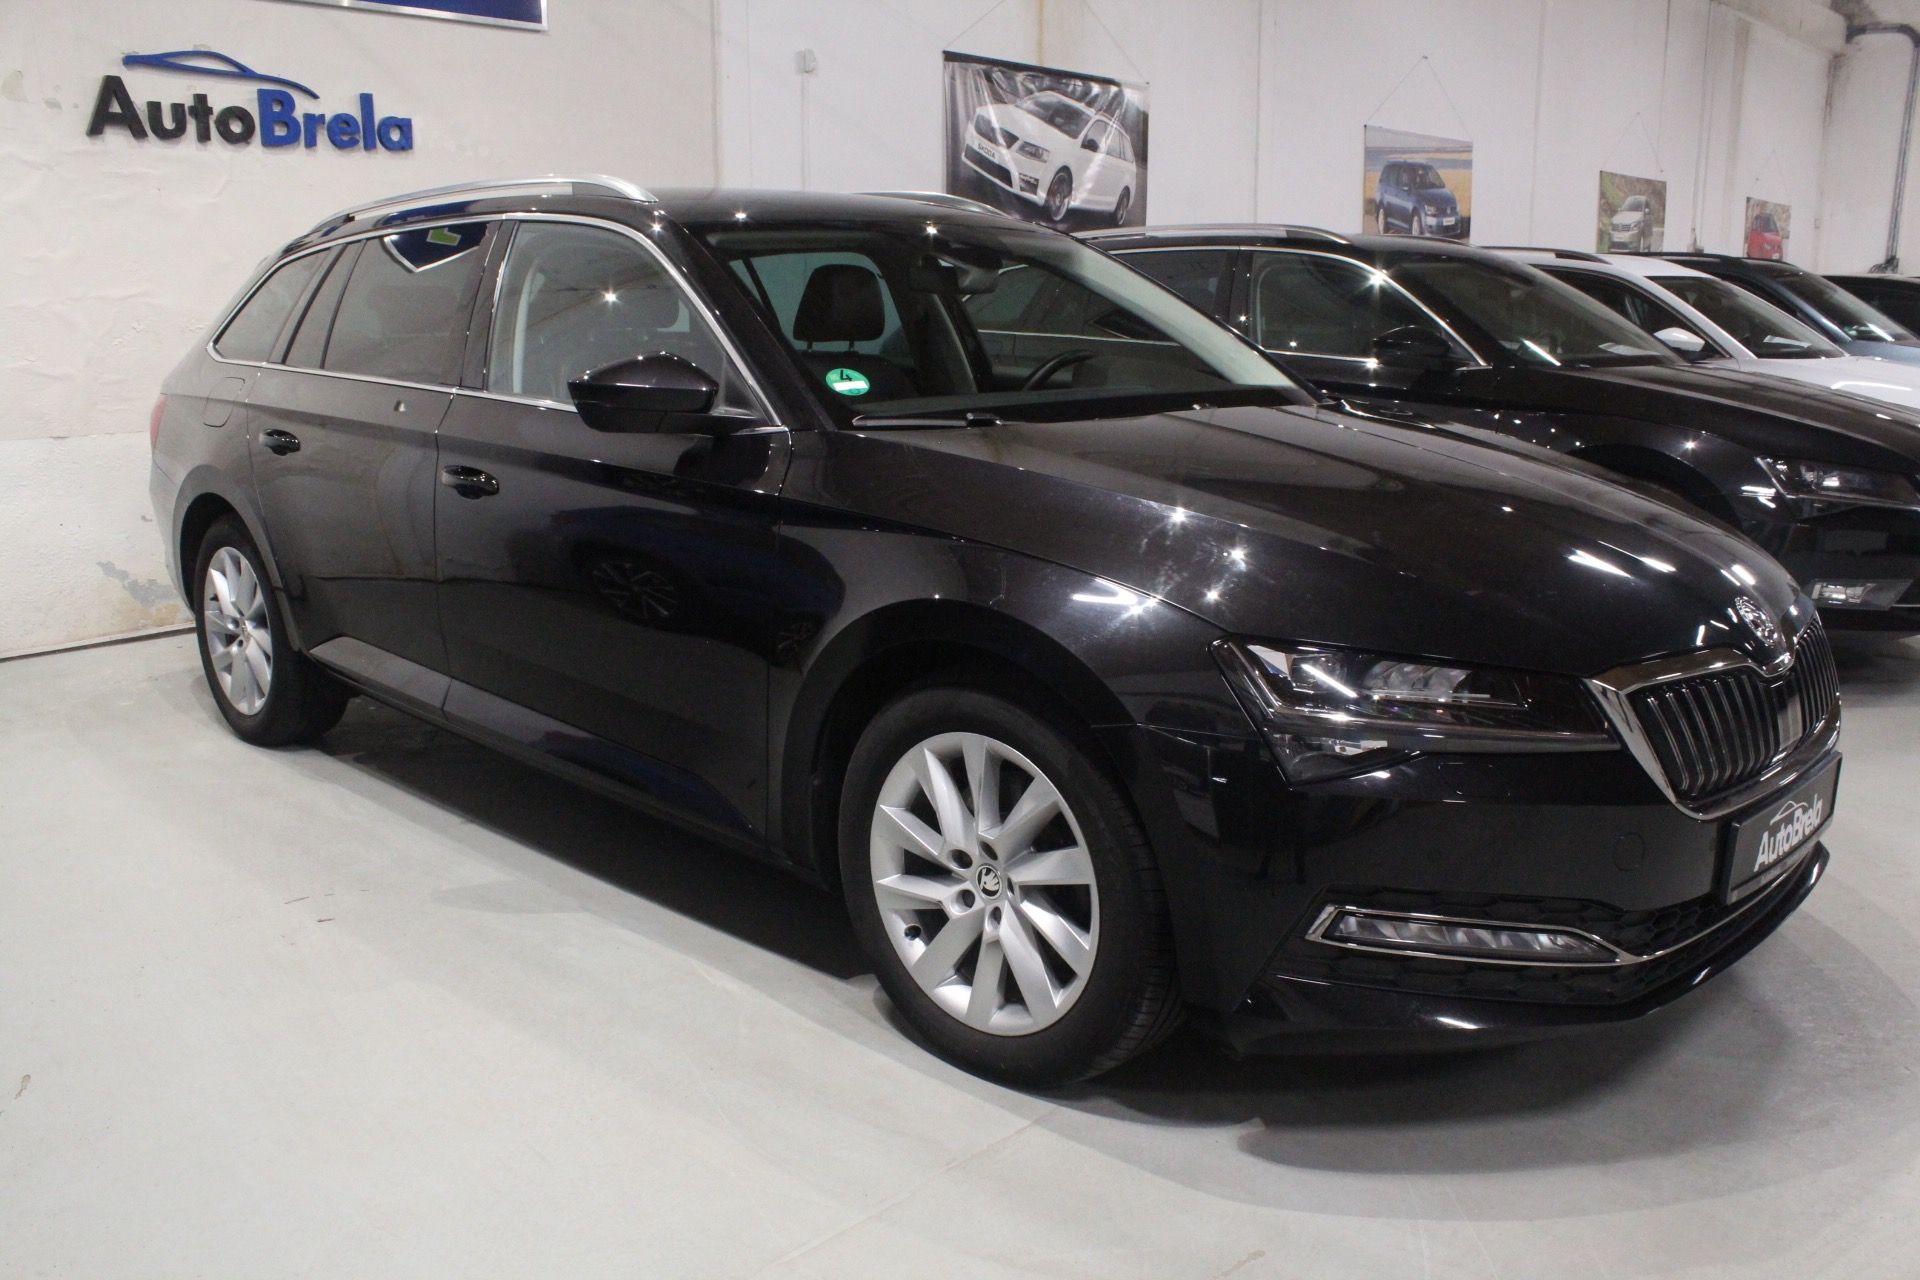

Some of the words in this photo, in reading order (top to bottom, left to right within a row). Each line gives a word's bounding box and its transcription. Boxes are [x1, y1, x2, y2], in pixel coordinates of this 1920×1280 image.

[86, 75, 414, 151] AutoBrela
[840, 369, 853, 382] 4
[1754, 794, 1823, 872] AutoBrela
